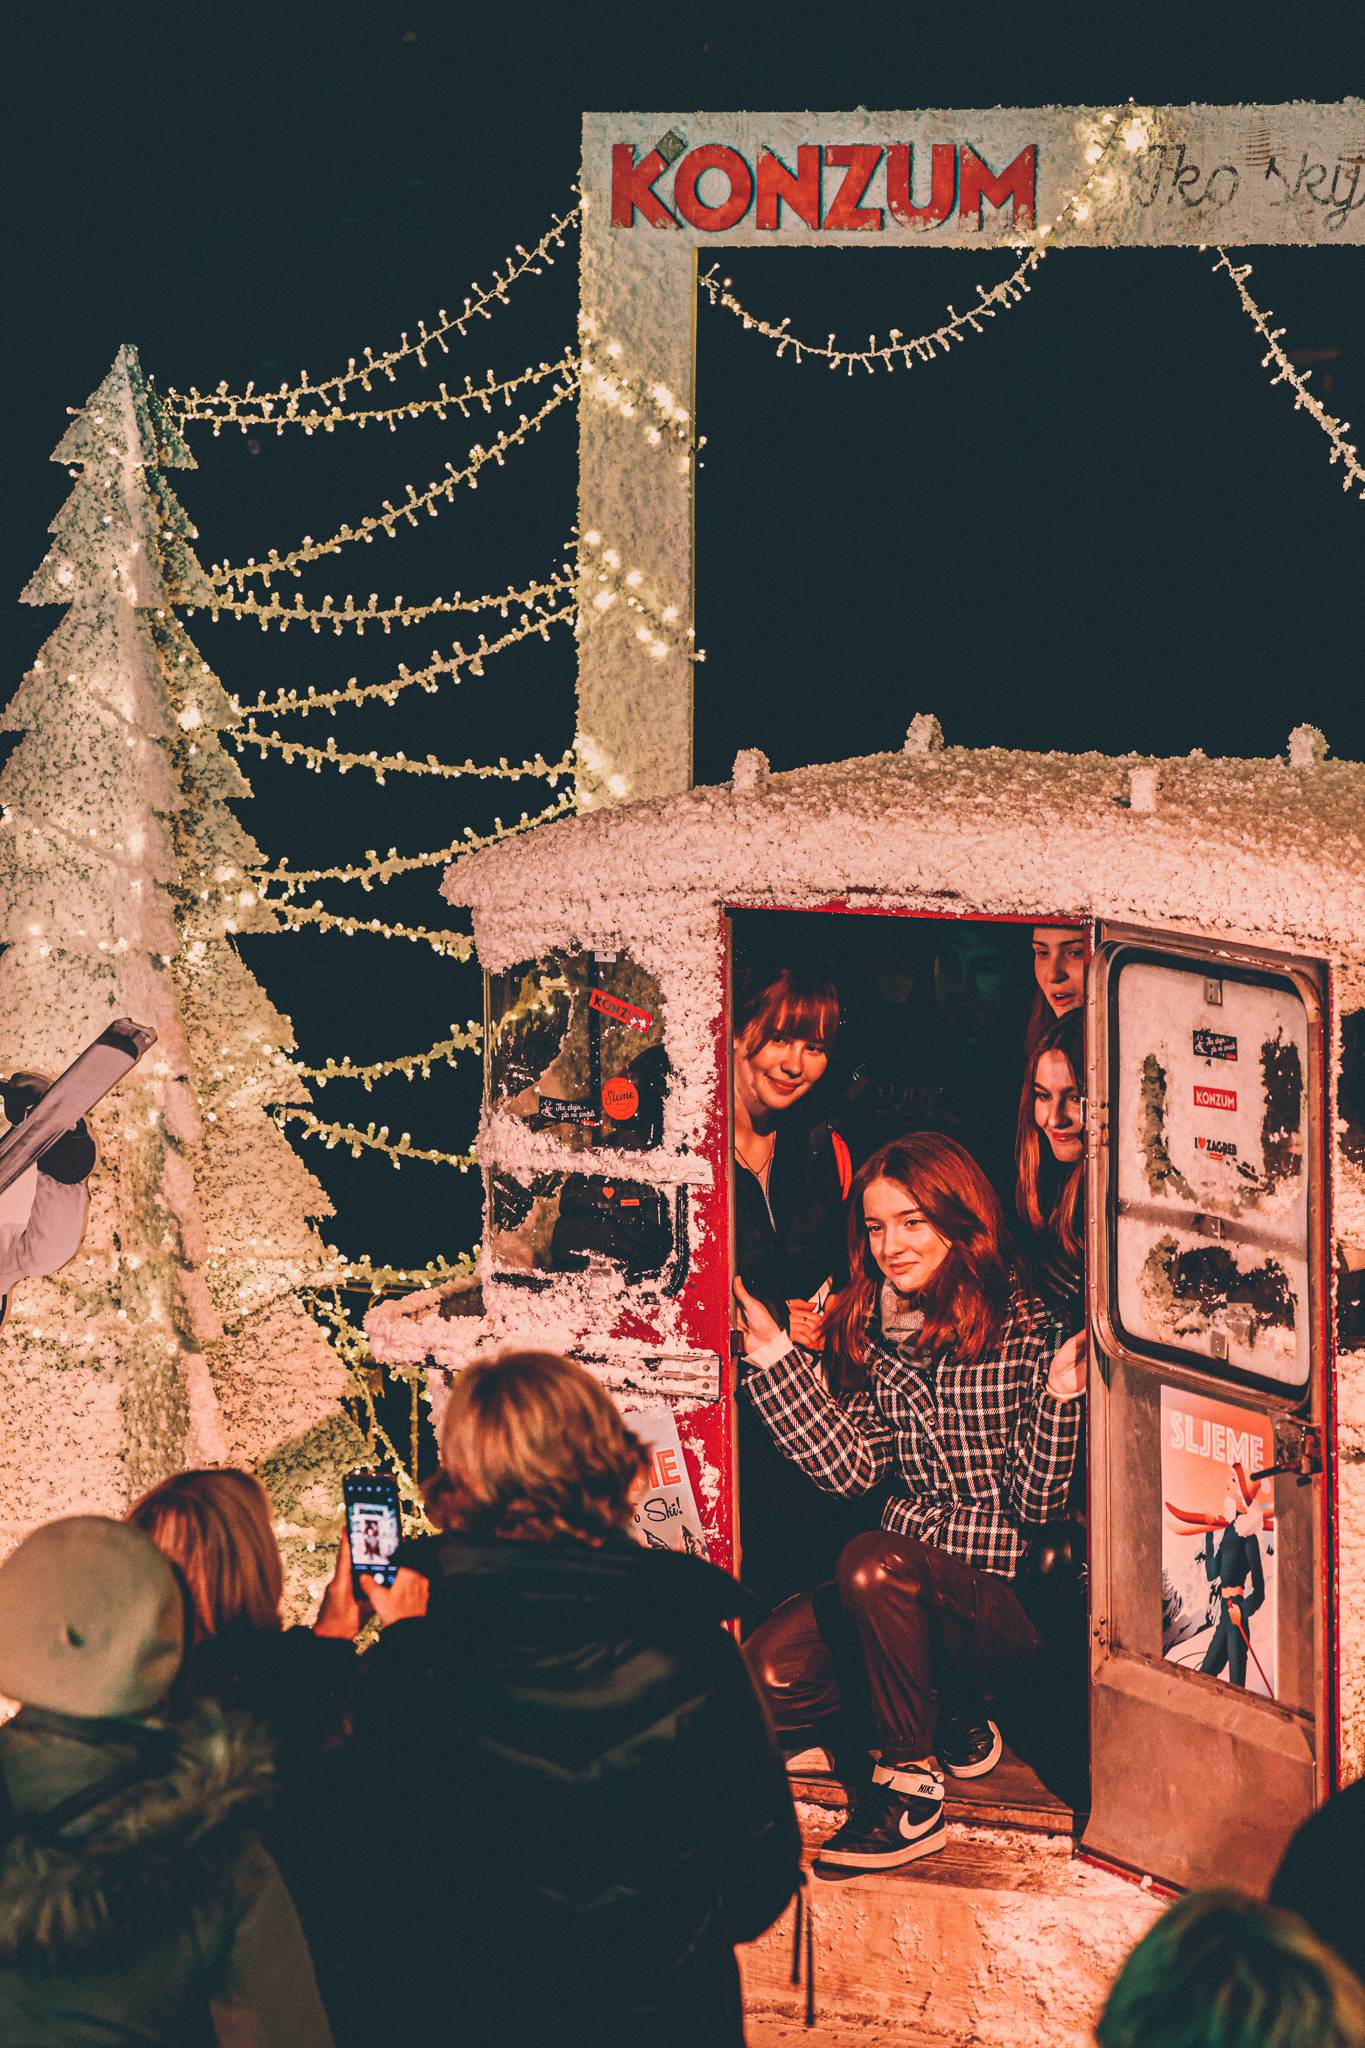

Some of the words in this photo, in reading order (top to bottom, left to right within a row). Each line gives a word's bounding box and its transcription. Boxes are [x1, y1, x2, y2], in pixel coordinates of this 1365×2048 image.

[611, 143, 1038, 232] KONZUM
[593, 994, 648, 1027] KONZU
[1196, 1091, 1235, 1108] KONZUM
[1206, 1139, 1237, 1156] ZAGREB
[1170, 1411, 1263, 1472] SLJEME
[644, 1497, 683, 1522] Ski!
[917, 1783, 936, 1795] NIKE
